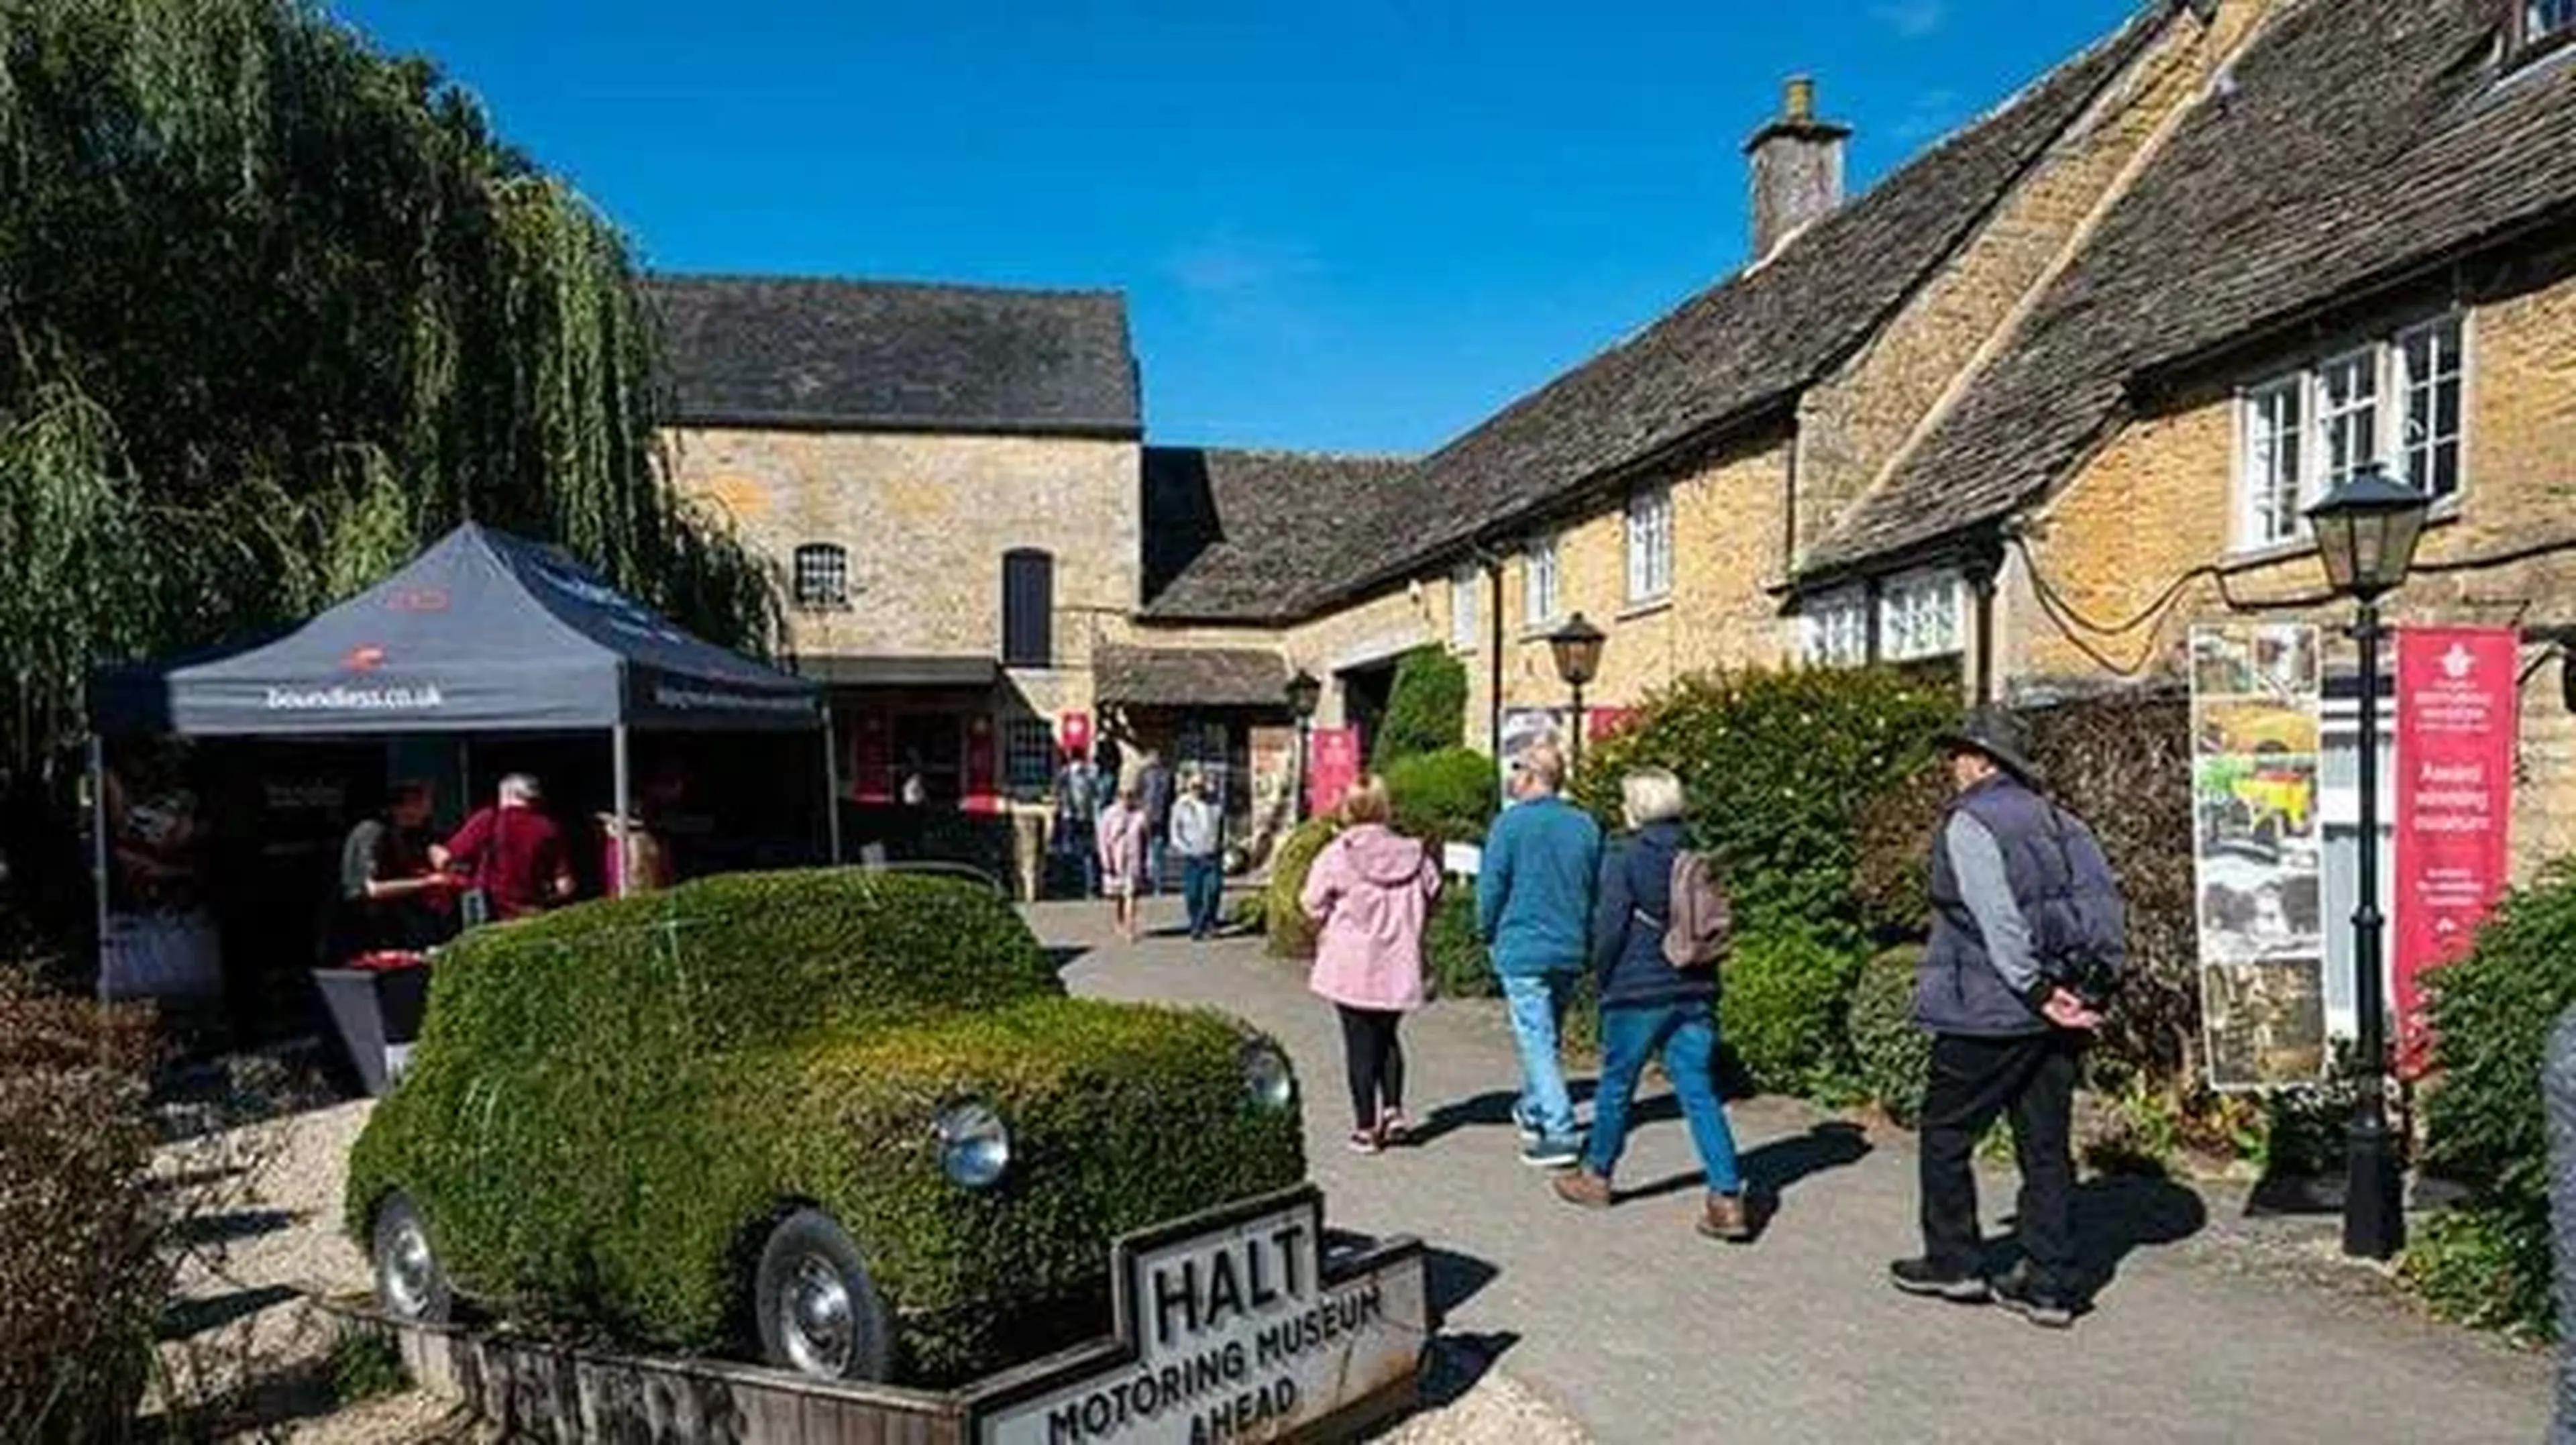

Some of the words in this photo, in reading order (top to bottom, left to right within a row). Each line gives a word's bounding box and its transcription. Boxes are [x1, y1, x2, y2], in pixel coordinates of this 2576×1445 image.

[266, 682, 442, 709] boundless.co.uk
[1152, 1224, 1304, 1342] HALT
[1048, 1340, 1245, 1445] MOTORING
[1256, 1285, 1382, 1367] MUSEUM
[1190, 1377, 1297, 1445] AHEAD
